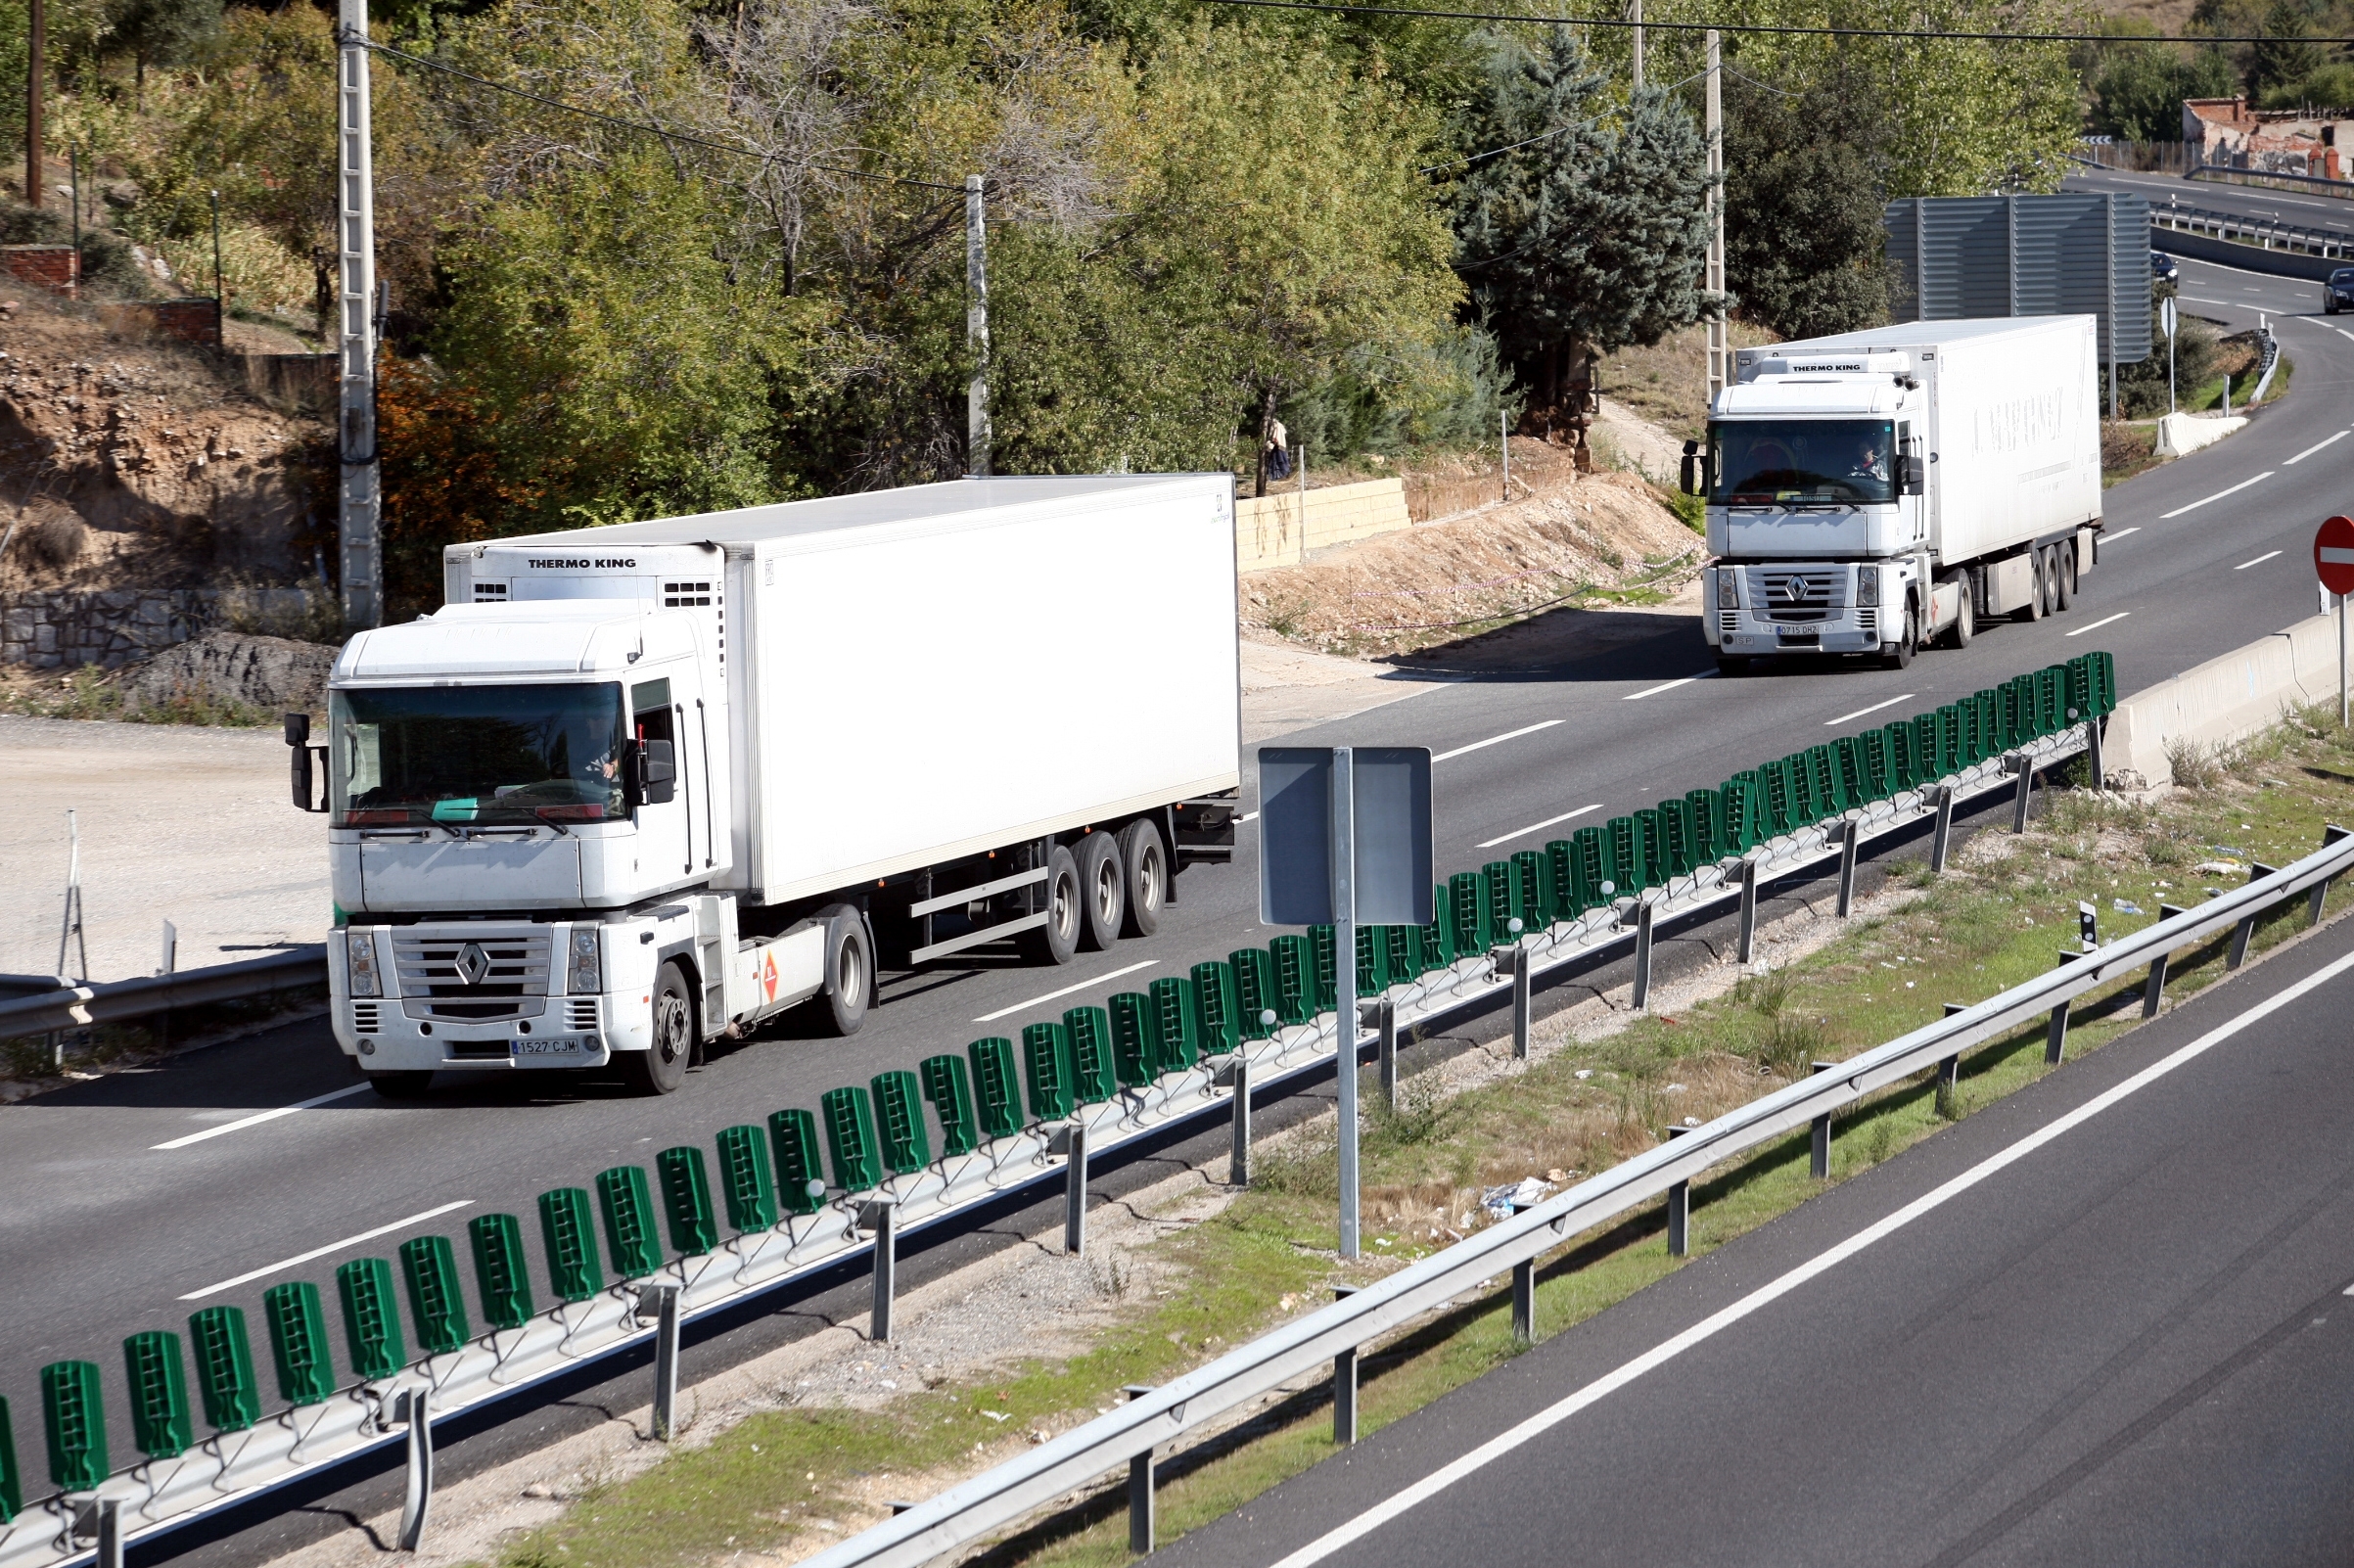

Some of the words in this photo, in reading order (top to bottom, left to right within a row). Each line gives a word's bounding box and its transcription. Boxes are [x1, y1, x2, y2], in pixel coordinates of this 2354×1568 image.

[528, 559, 591, 569] THERMO
[594, 558, 636, 568] KING
[520, 1041, 549, 1053] 1527
[552, 1040, 576, 1052] CJM
